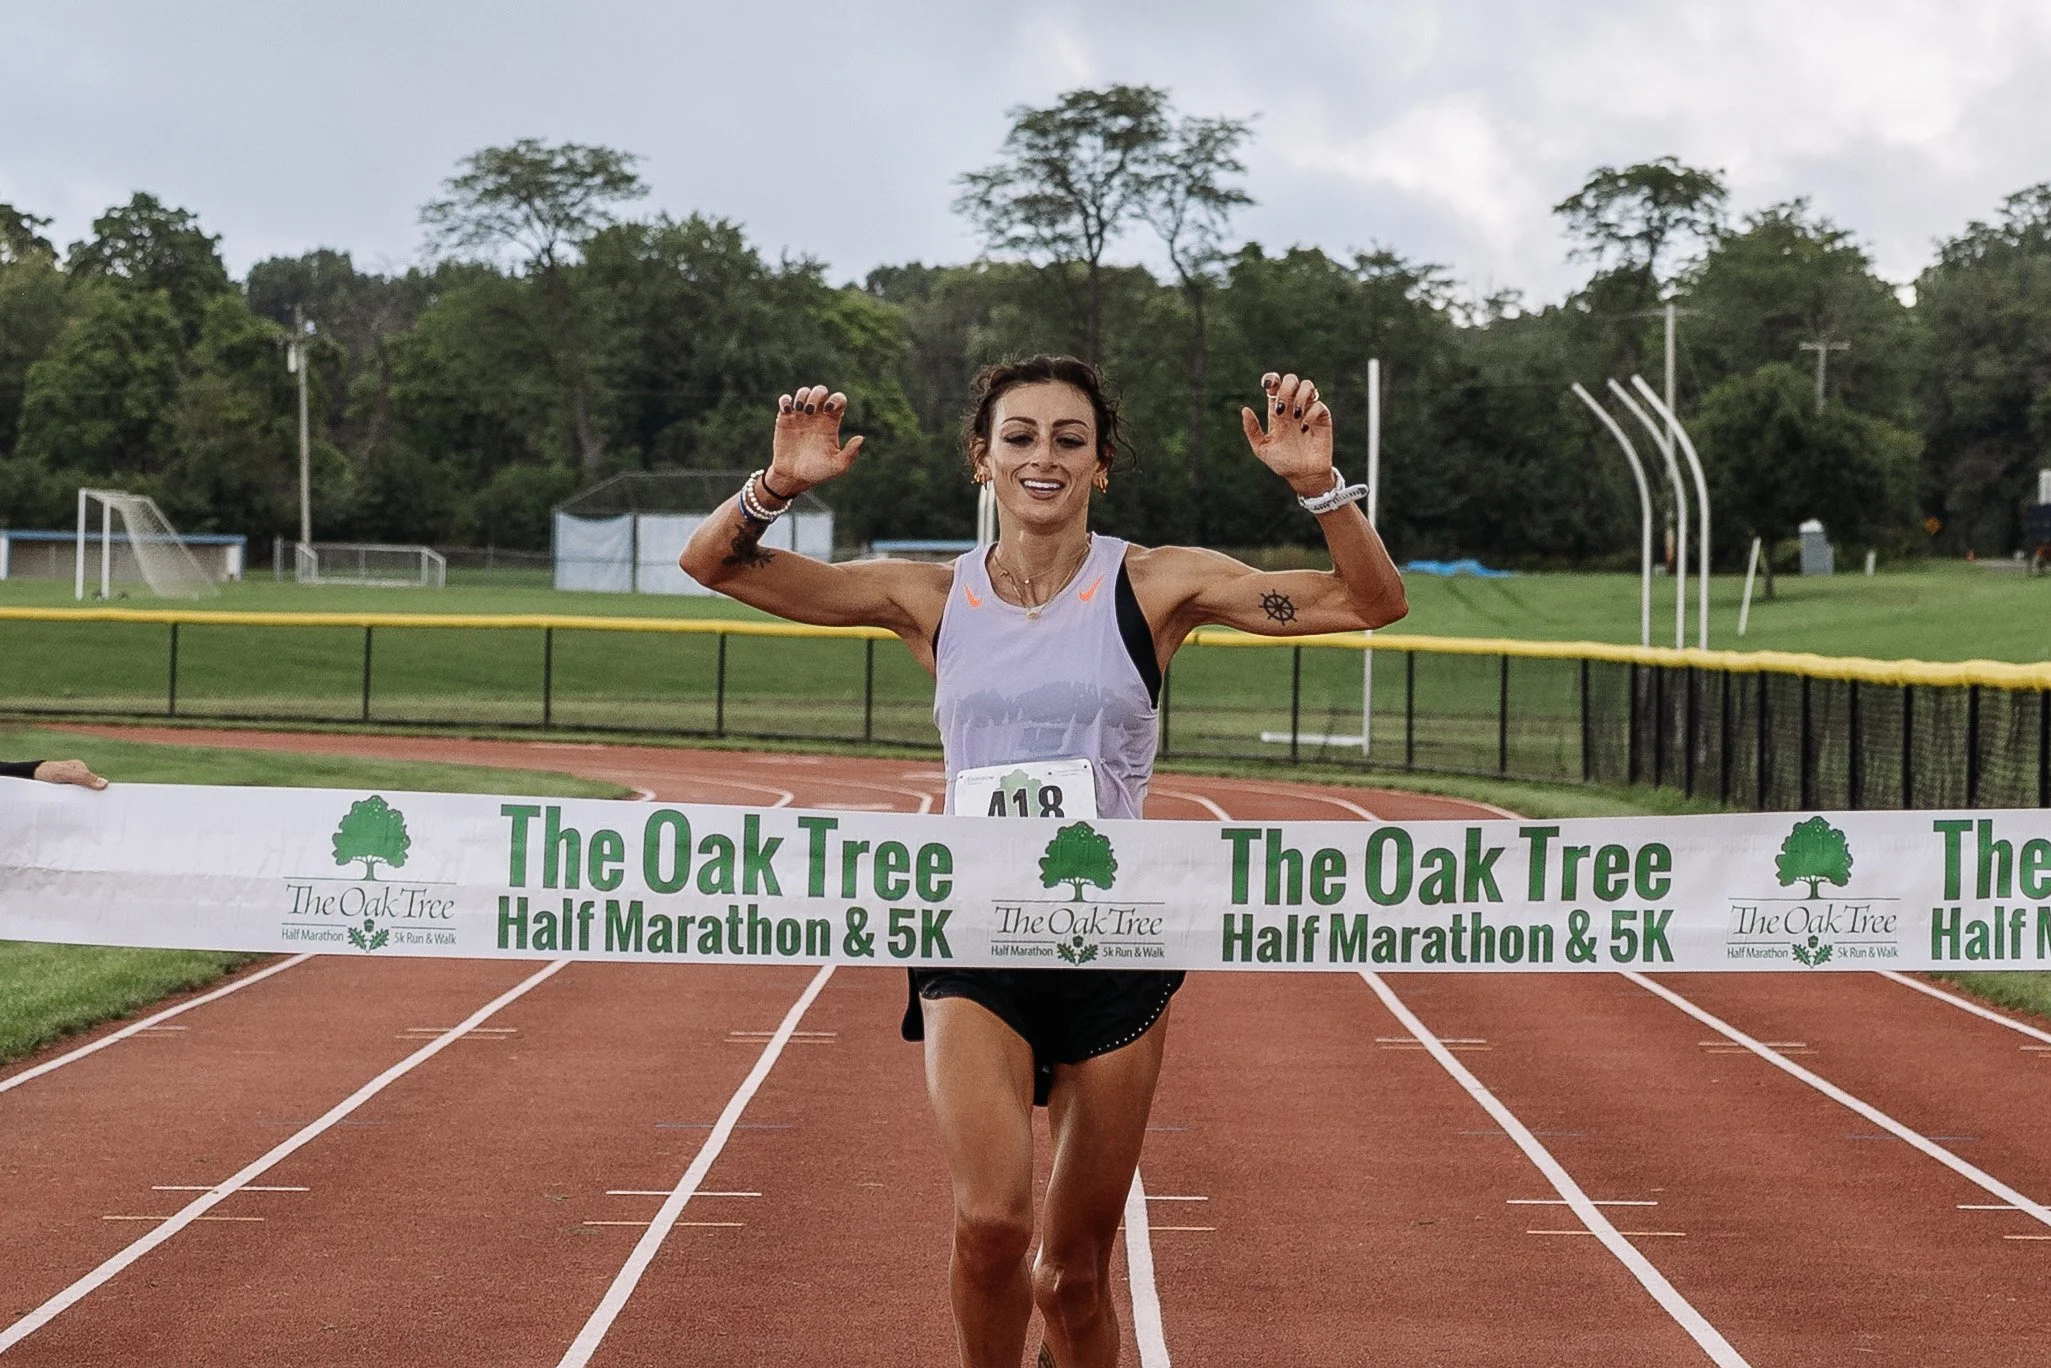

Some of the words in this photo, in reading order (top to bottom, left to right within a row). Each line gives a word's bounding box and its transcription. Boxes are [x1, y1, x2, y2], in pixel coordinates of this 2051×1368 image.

[500, 804, 624, 893] The
[642, 809, 786, 897] Oak
[797, 816, 954, 902] Tree
[1220, 828, 1347, 906] The
[1364, 826, 1506, 906] Oak
[1519, 826, 1673, 903] Tree
[1932, 818, 2051, 900] The
[286, 884, 335, 916] The
[339, 886, 400, 918] Oak
[401, 888, 455, 919] Tree
[497, 896, 595, 951] Half
[605, 899, 831, 956] Marathon
[843, 906, 875, 957] &
[887, 908, 954, 958] 5K
[995, 906, 1044, 934] The
[1048, 906, 1108, 935] Oak
[1109, 908, 1163, 936] Tree
[1731, 905, 1780, 934] The
[1784, 904, 1843, 934] Oak
[1844, 904, 1897, 934] Tree
[1931, 905, 2027, 960] Half
[281, 928, 300, 941] Half
[301, 929, 344, 942] Marathon
[394, 931, 405, 944] 5k
[406, 932, 424, 945] Run
[426, 933, 433, 945] &
[434, 933, 457, 946] Walk
[1221, 912, 1320, 962] Half
[1329, 911, 1554, 963] Marathon
[1566, 909, 1597, 963] &
[1609, 909, 1675, 963] 5K
[991, 945, 1010, 957] Half
[1010, 945, 1054, 957] Marathon
[1102, 946, 1114, 958] 5k
[1115, 946, 1133, 958] Run
[1134, 946, 1142, 958] &
[1143, 946, 1165, 959] Walk
[1727, 947, 1746, 959] Half
[1746, 947, 1789, 959] Marathon
[1837, 947, 1849, 959] 5k
[1849, 947, 1867, 959] Run
[1868, 947, 1876, 959] &
[1877, 947, 1899, 959] Walk
